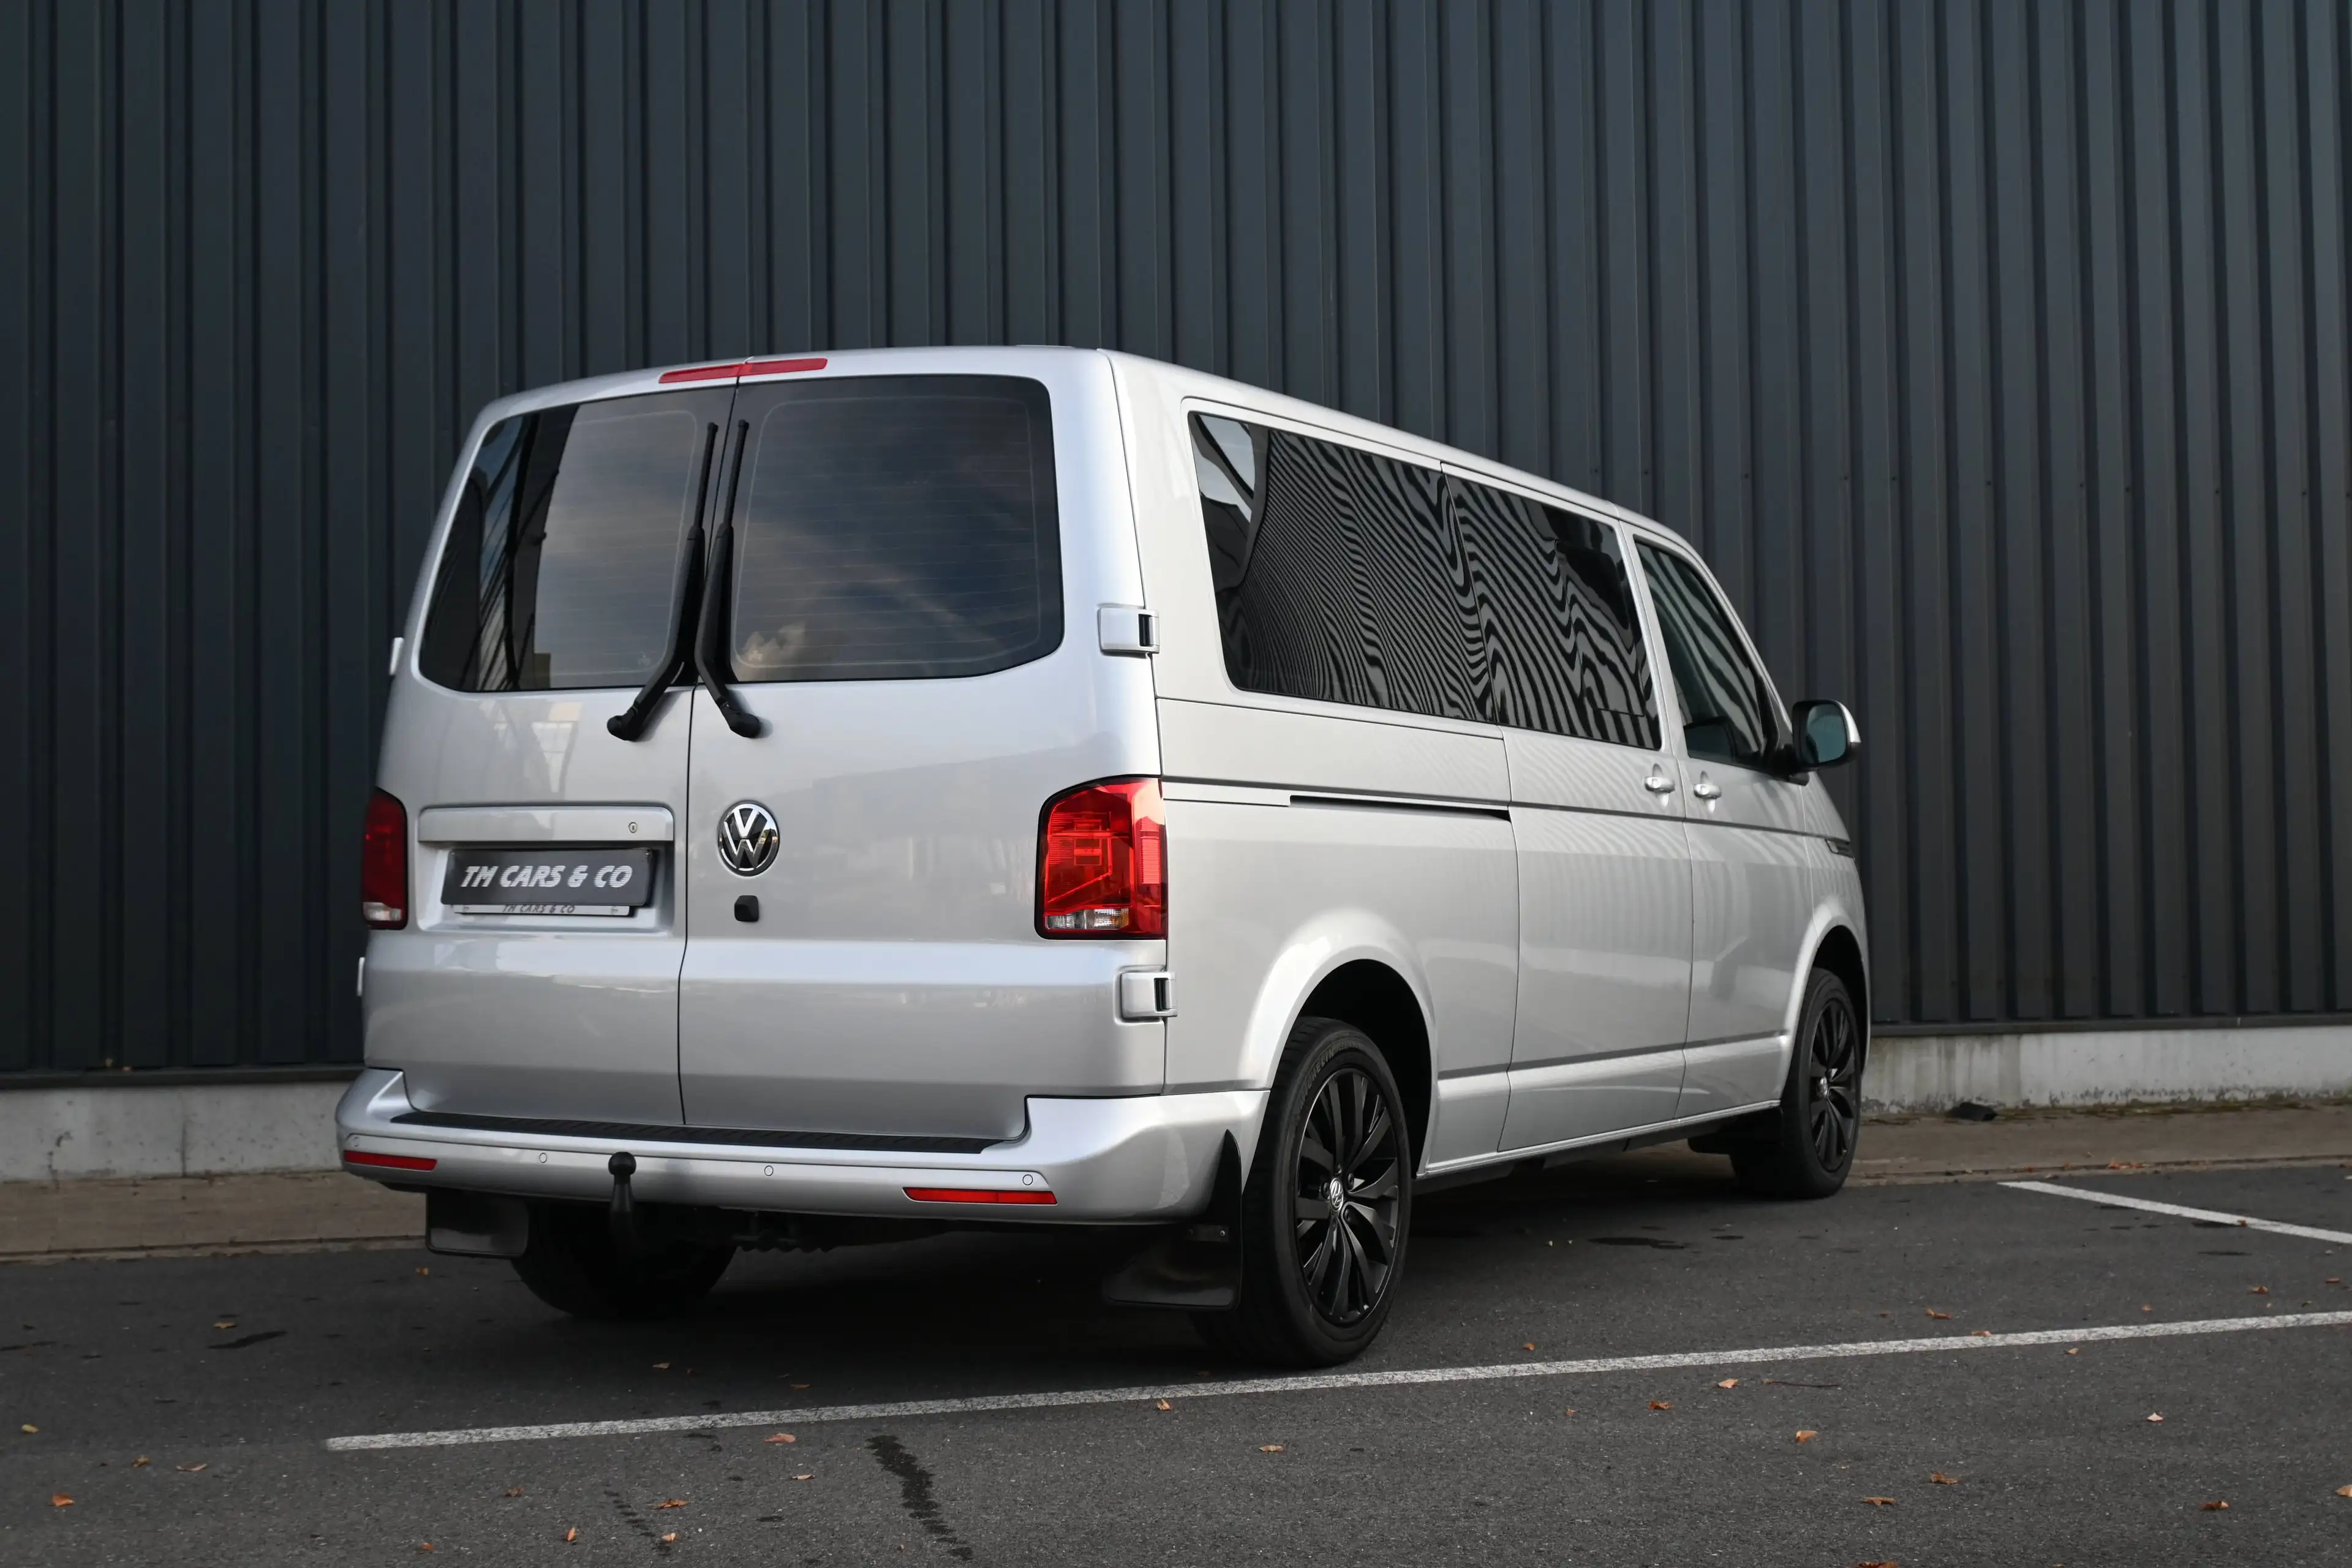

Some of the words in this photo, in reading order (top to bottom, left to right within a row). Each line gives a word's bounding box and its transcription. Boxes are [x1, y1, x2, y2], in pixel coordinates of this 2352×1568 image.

[720, 803, 775, 872] VW
[460, 865, 499, 888] TM
[500, 865, 566, 888] CARS
[567, 865, 588, 888] &
[594, 865, 633, 888] CO
[519, 905, 547, 913] CARS
